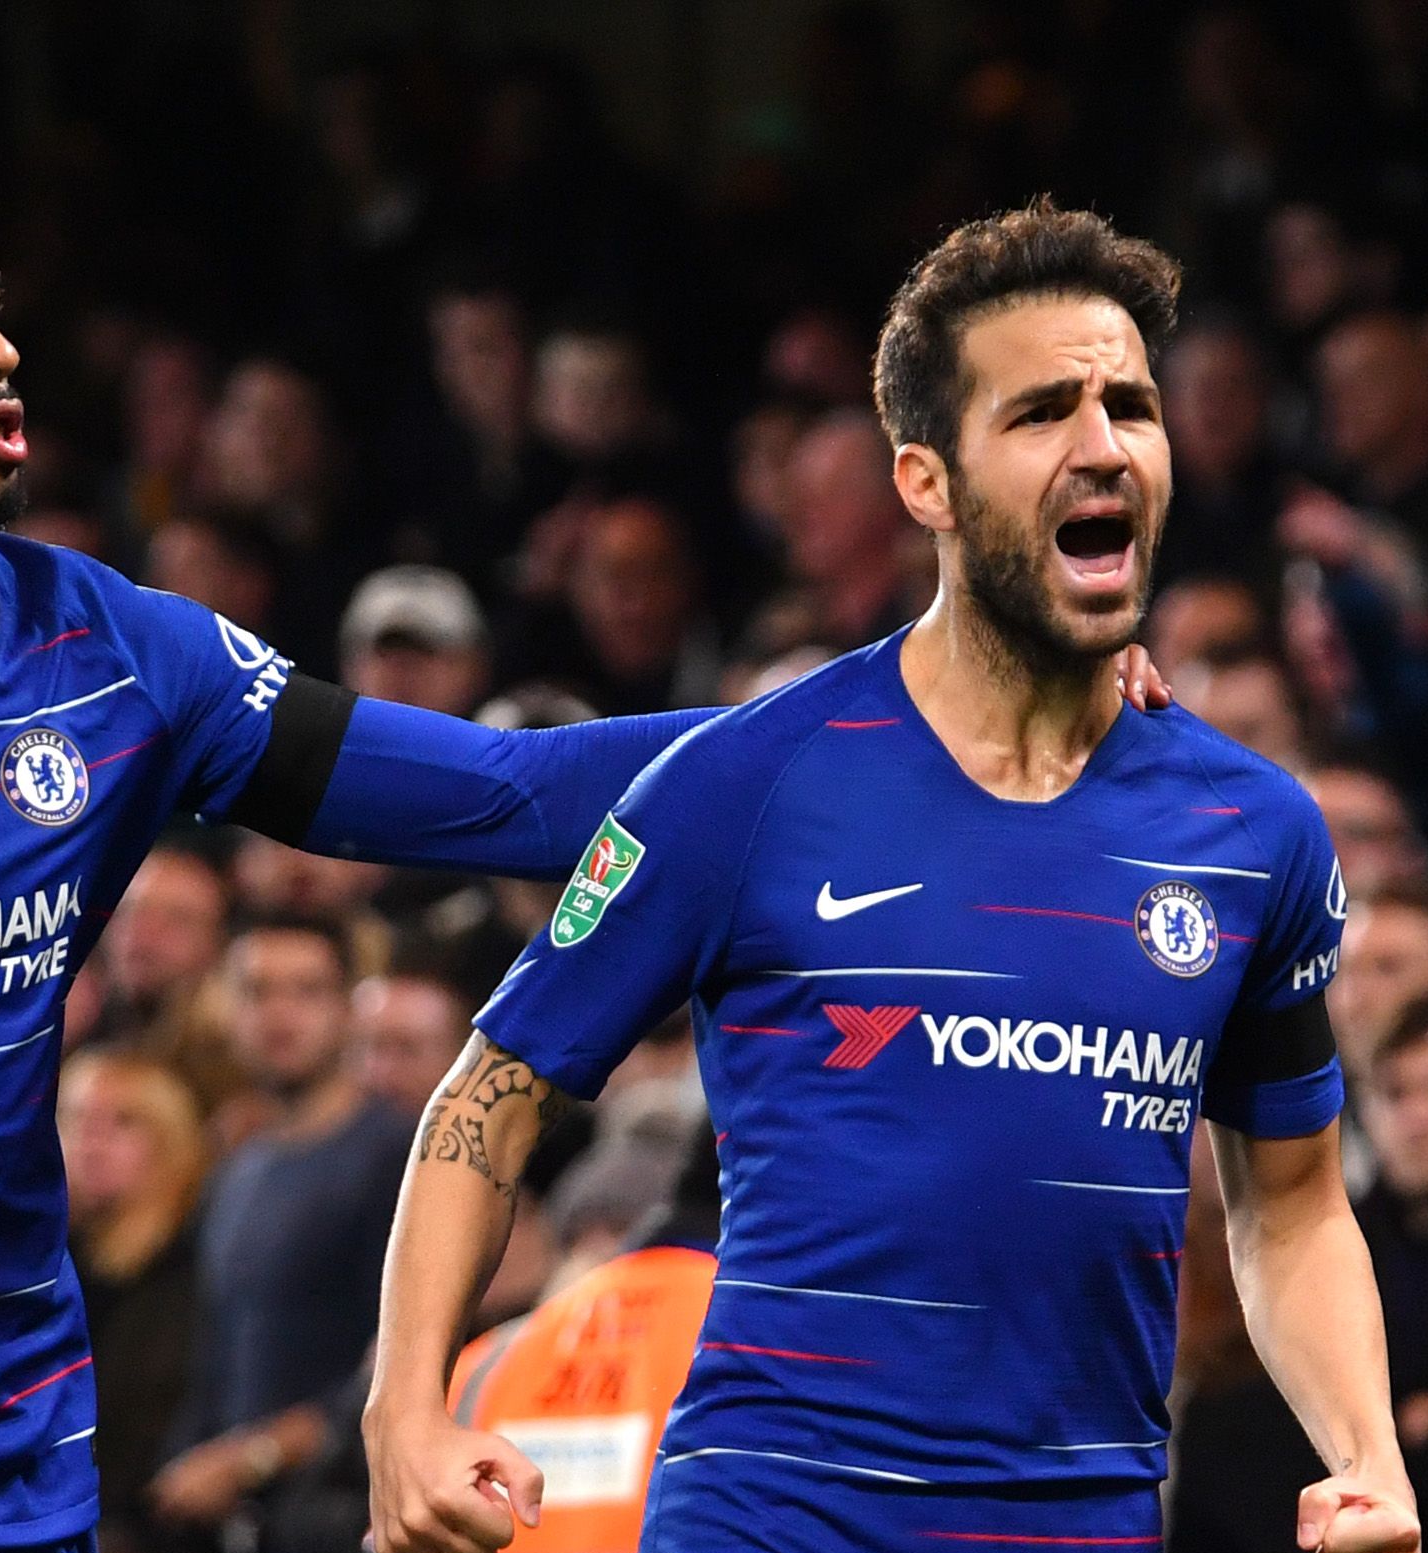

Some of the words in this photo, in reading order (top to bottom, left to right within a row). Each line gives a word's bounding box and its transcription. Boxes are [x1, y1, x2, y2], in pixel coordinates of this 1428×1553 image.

[11, 733, 65, 758] CHELSEA
[1150, 884, 1203, 909] CHELSEA
[920, 1013, 1204, 1087] YOKOHAMA
[1101, 1090, 1191, 1134] TYRES
